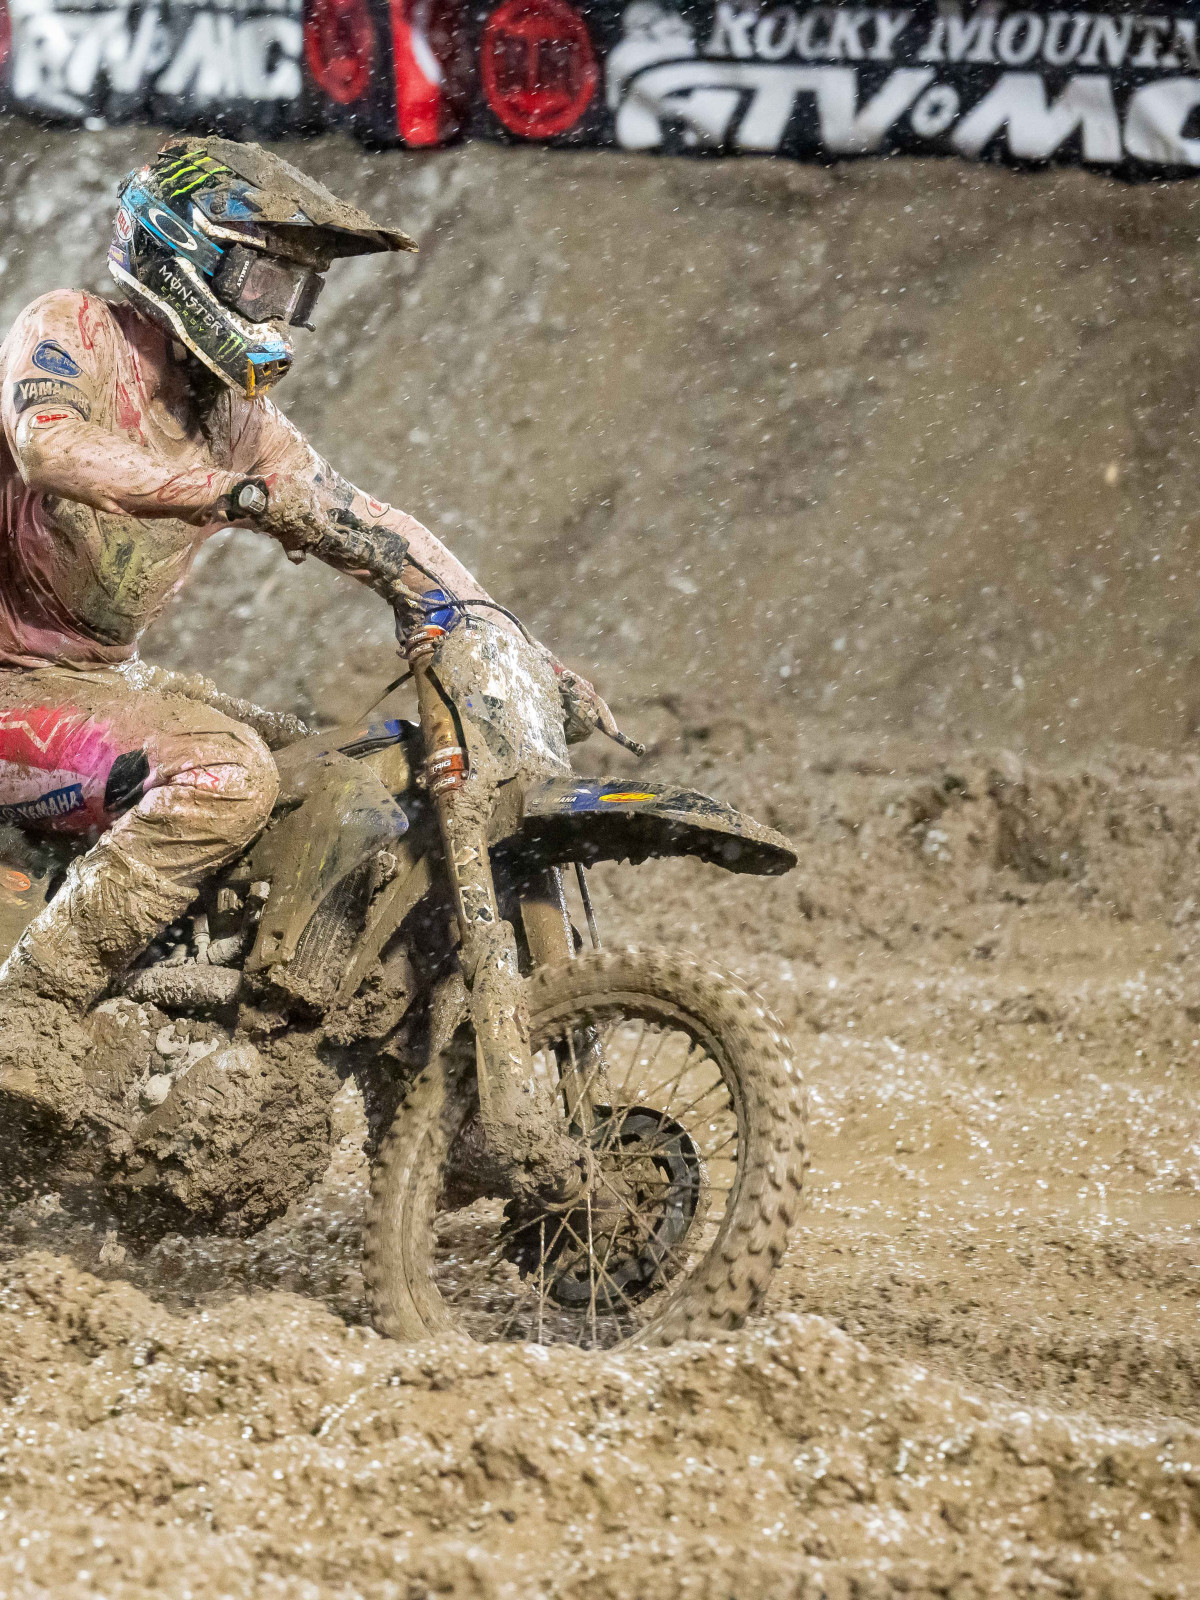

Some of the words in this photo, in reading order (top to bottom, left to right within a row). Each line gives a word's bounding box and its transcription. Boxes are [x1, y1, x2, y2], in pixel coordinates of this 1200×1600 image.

[704, 2, 912, 60] ROCKY
[117, 210, 130, 237] BELL
[158, 264, 223, 337] MONSTER
[16, 790, 81, 820] YAMAHA
